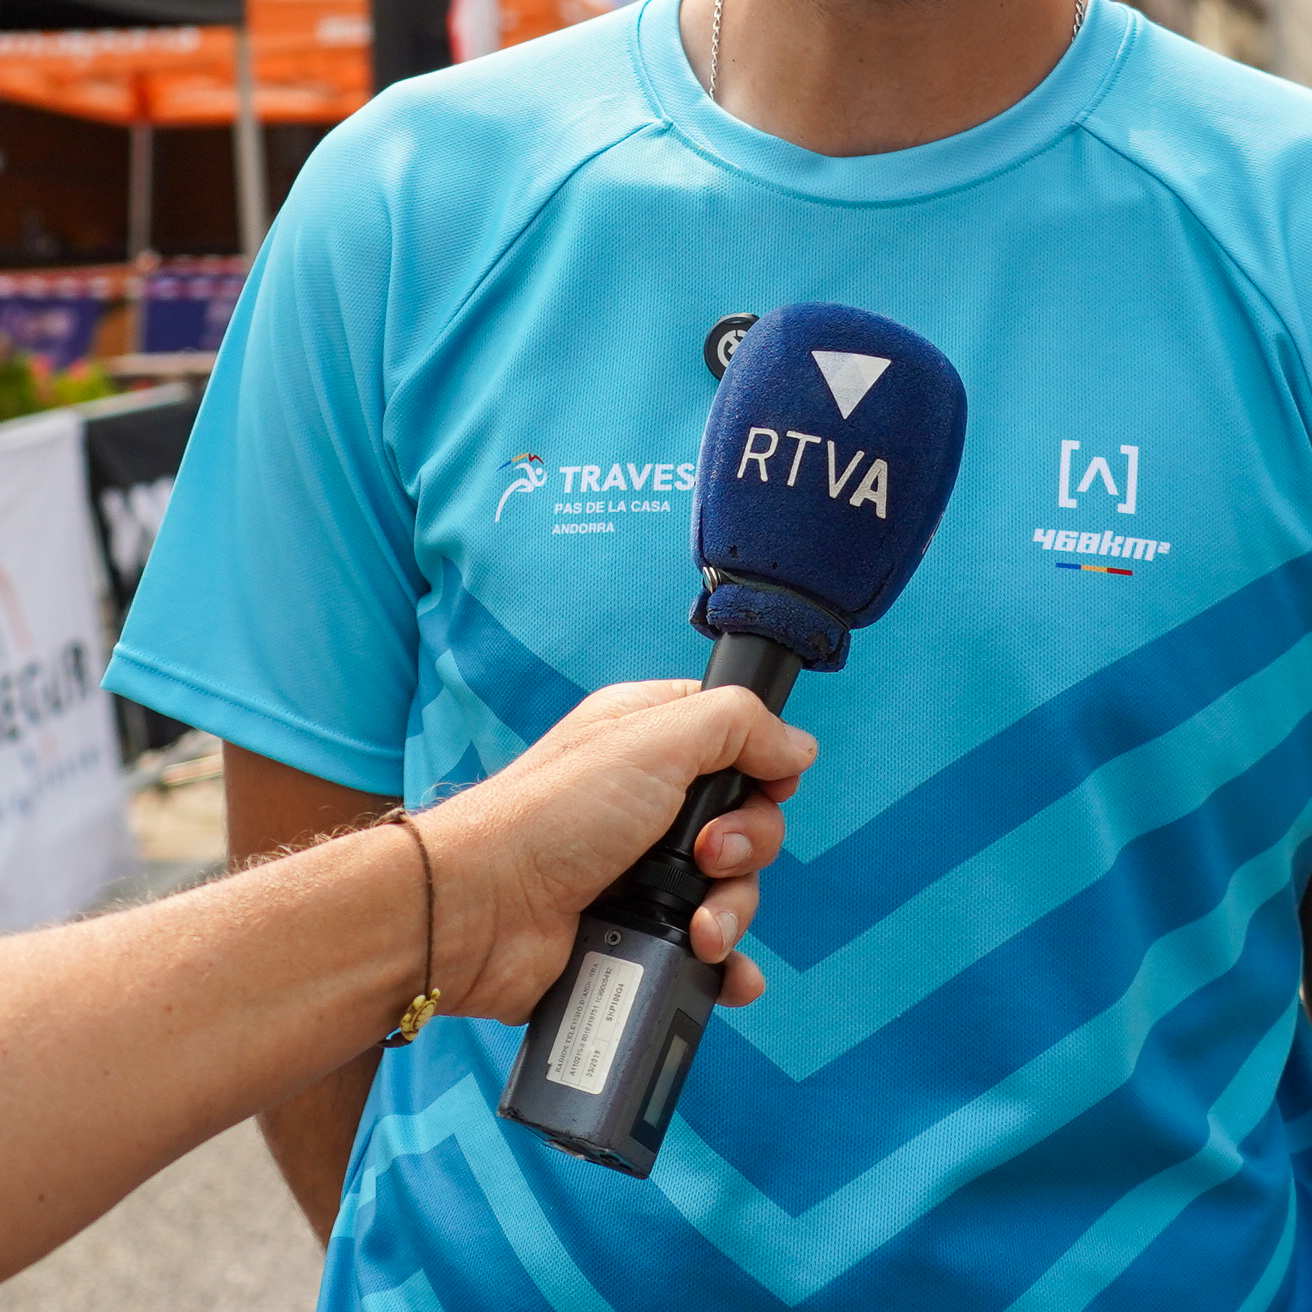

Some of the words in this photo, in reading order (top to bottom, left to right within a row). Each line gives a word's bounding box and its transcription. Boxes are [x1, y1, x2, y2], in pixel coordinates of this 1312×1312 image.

[736, 426, 888, 520] RTVA
[554, 502, 582, 515] PAS
[586, 502, 605, 514] DE
[607, 501, 627, 513] LA
[630, 500, 671, 513] CASA
[551, 521, 615, 536] ANDORRA
